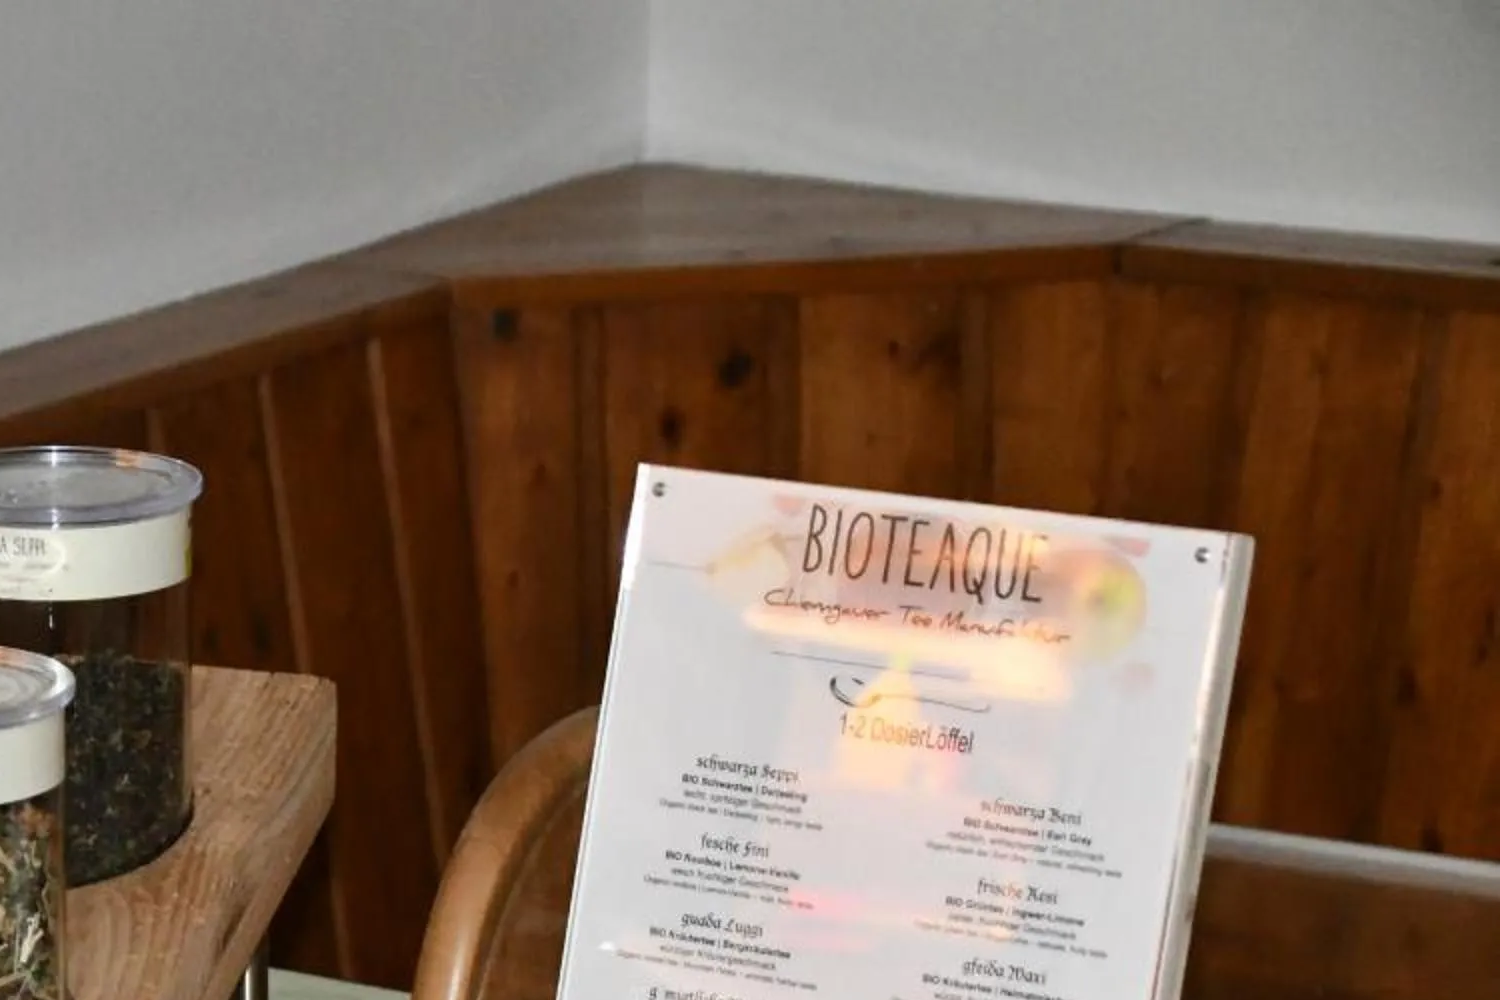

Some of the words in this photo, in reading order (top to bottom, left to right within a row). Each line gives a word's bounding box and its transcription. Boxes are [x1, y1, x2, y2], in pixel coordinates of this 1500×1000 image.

[802, 503, 1048, 604] BIOTEAQUE
[899, 604, 933, 627] Tee
[943, 611, 1071, 643] Manufktur
[839, 713, 867, 739] 1-2
